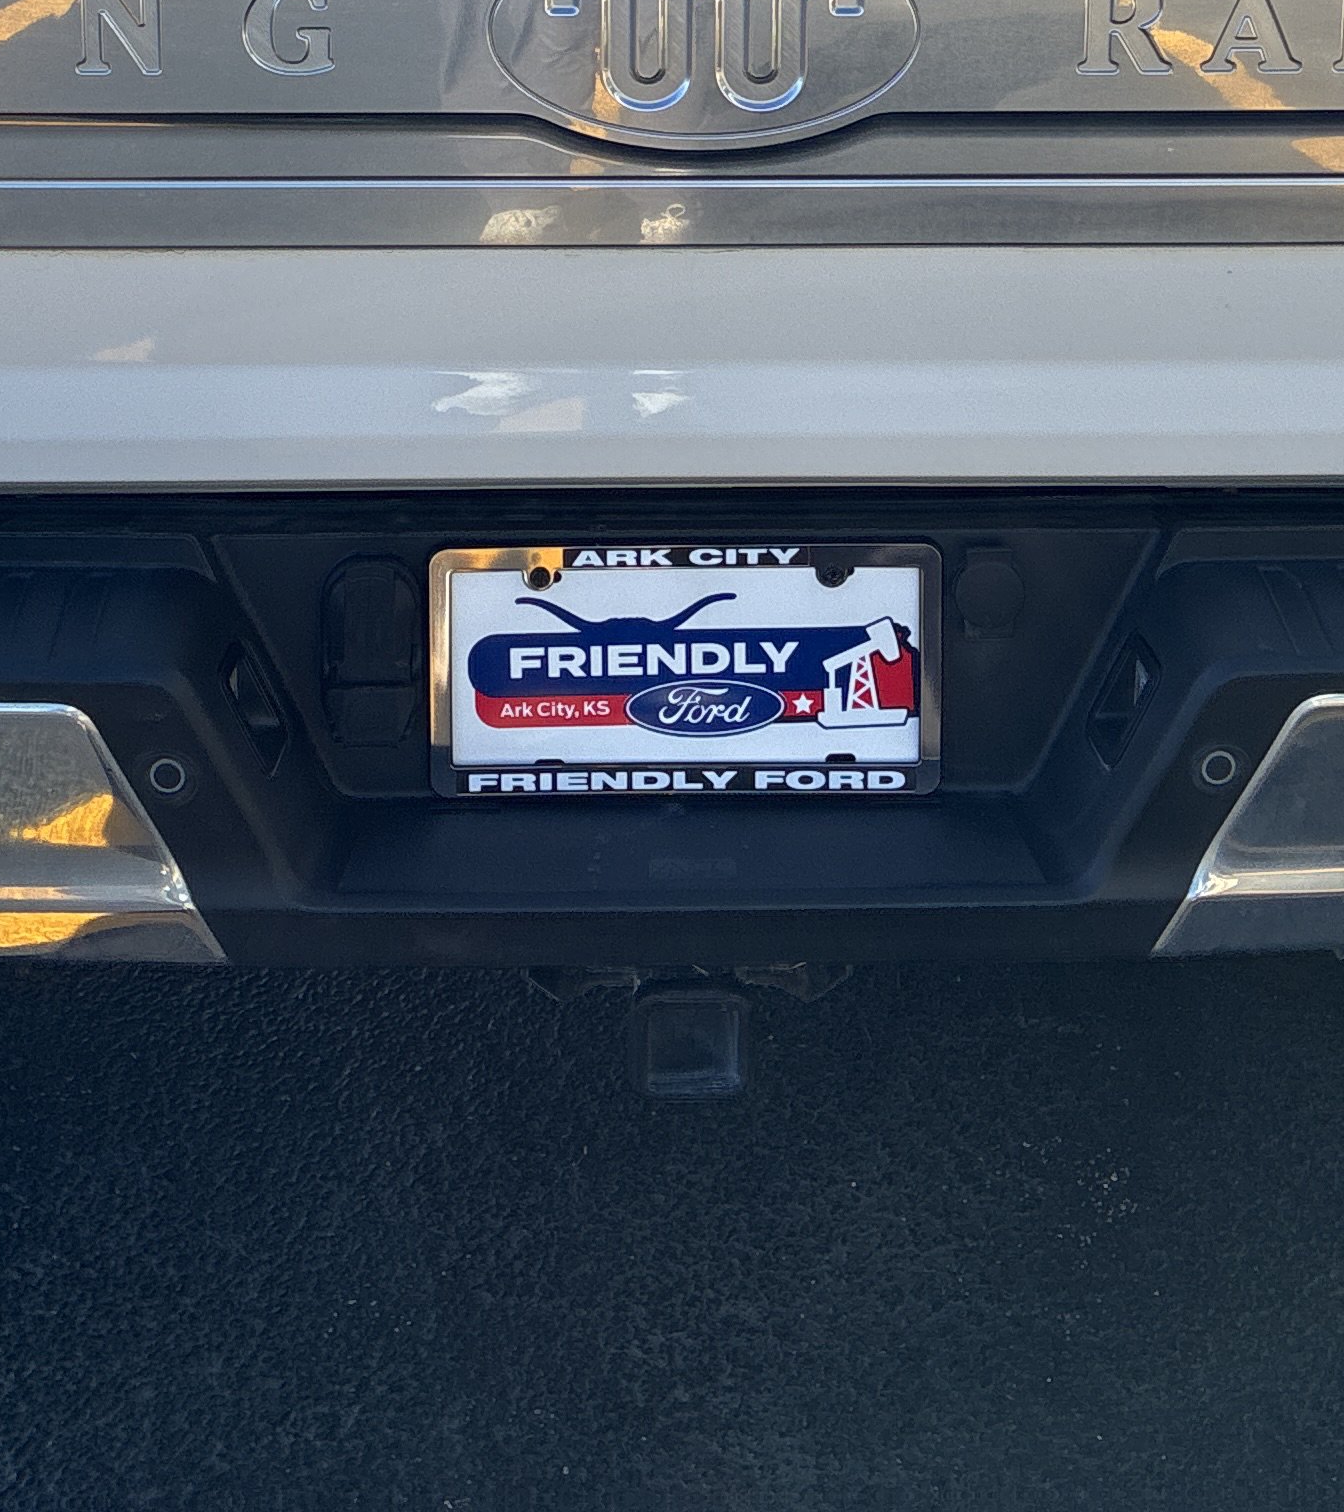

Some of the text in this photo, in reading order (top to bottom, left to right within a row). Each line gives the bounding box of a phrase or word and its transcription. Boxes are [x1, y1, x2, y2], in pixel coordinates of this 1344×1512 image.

[571, 547, 801, 567] ARK CITY
[508, 640, 800, 681] FRIENDLY
[499, 699, 611, 721] Ark City, KS
[657, 687, 751, 725] Ford
[467, 769, 906, 793] FRIENDLY FORD
